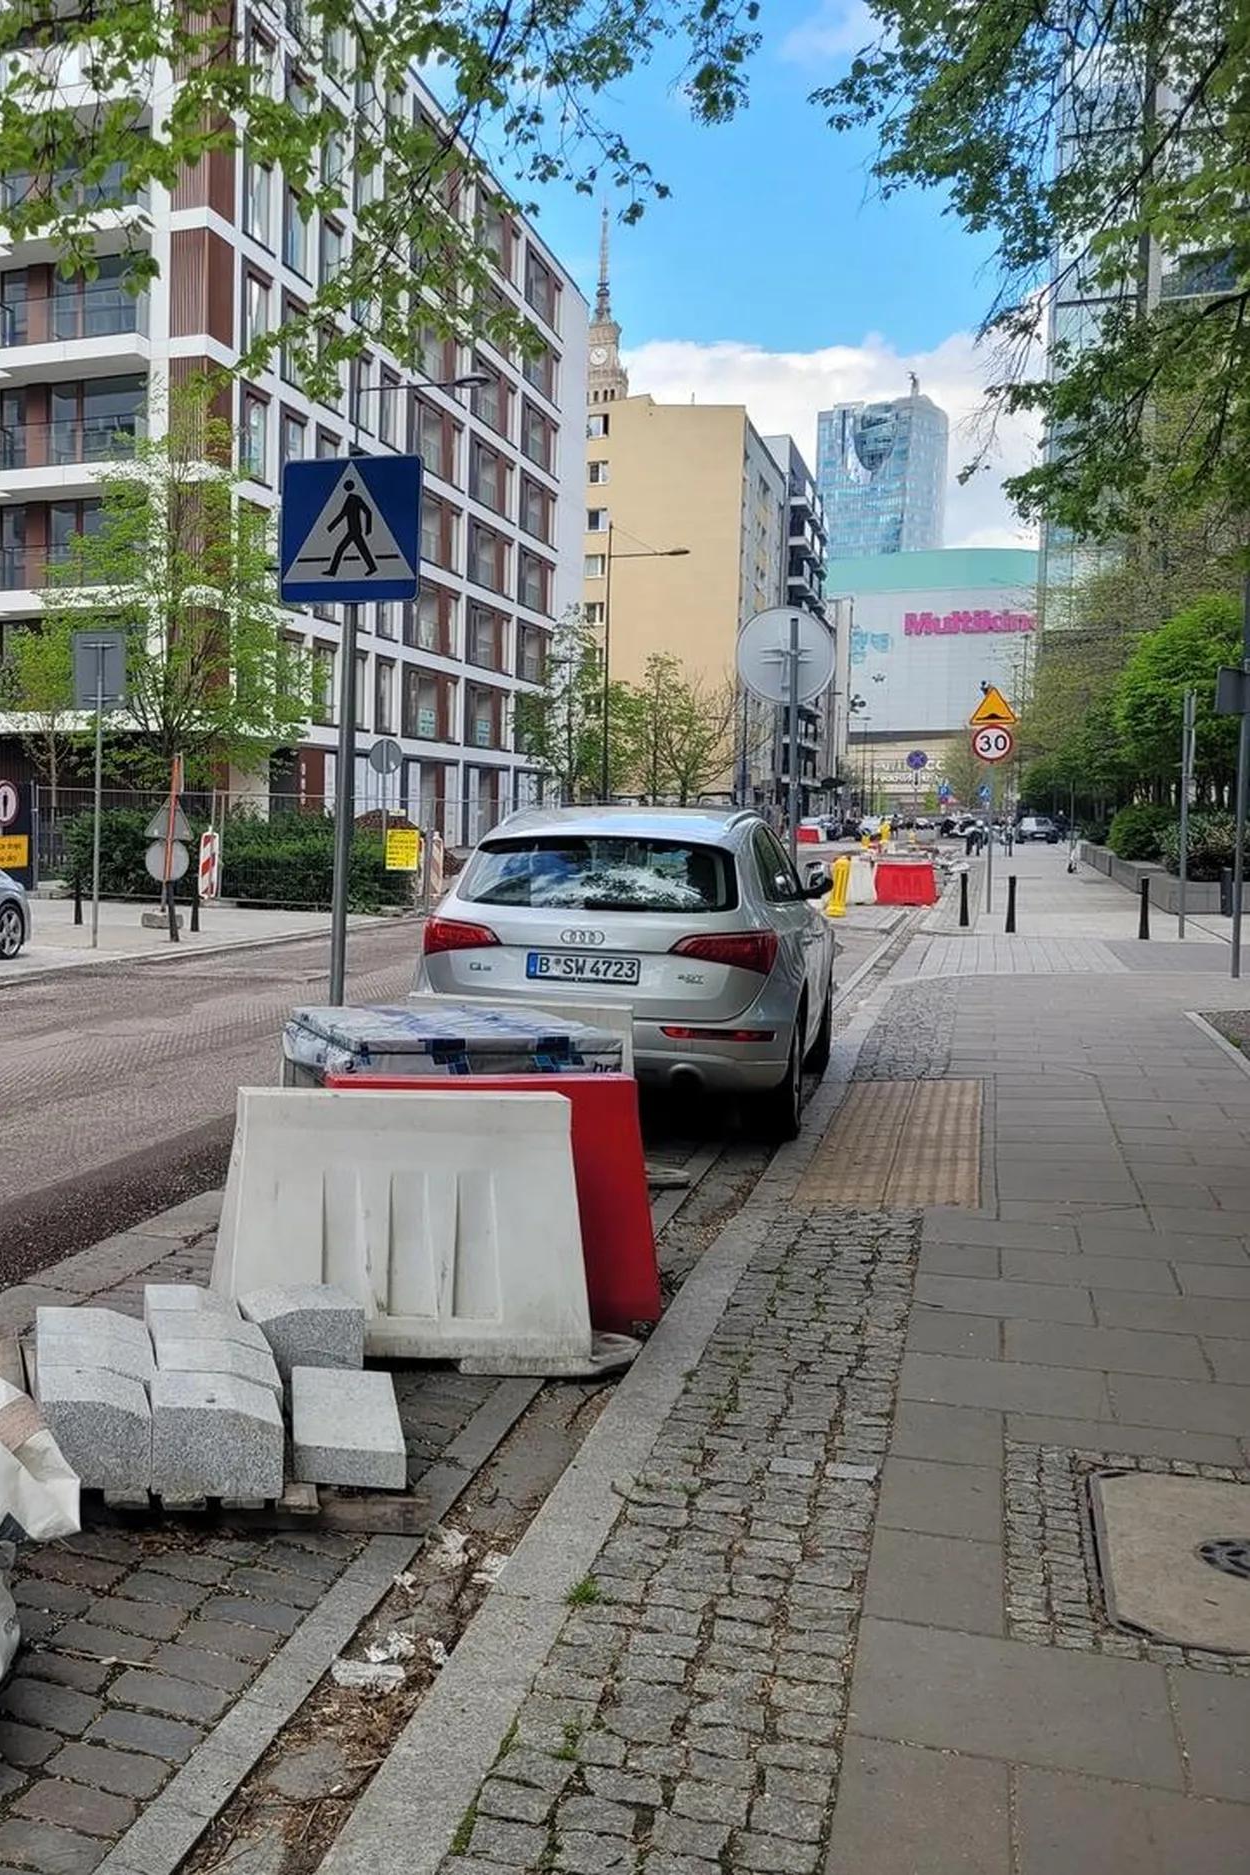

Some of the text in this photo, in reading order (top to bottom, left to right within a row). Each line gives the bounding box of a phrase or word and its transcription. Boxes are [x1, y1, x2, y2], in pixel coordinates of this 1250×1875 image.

[979, 734, 1008, 752] 30
[538, 958, 637, 978] B SW 4723
